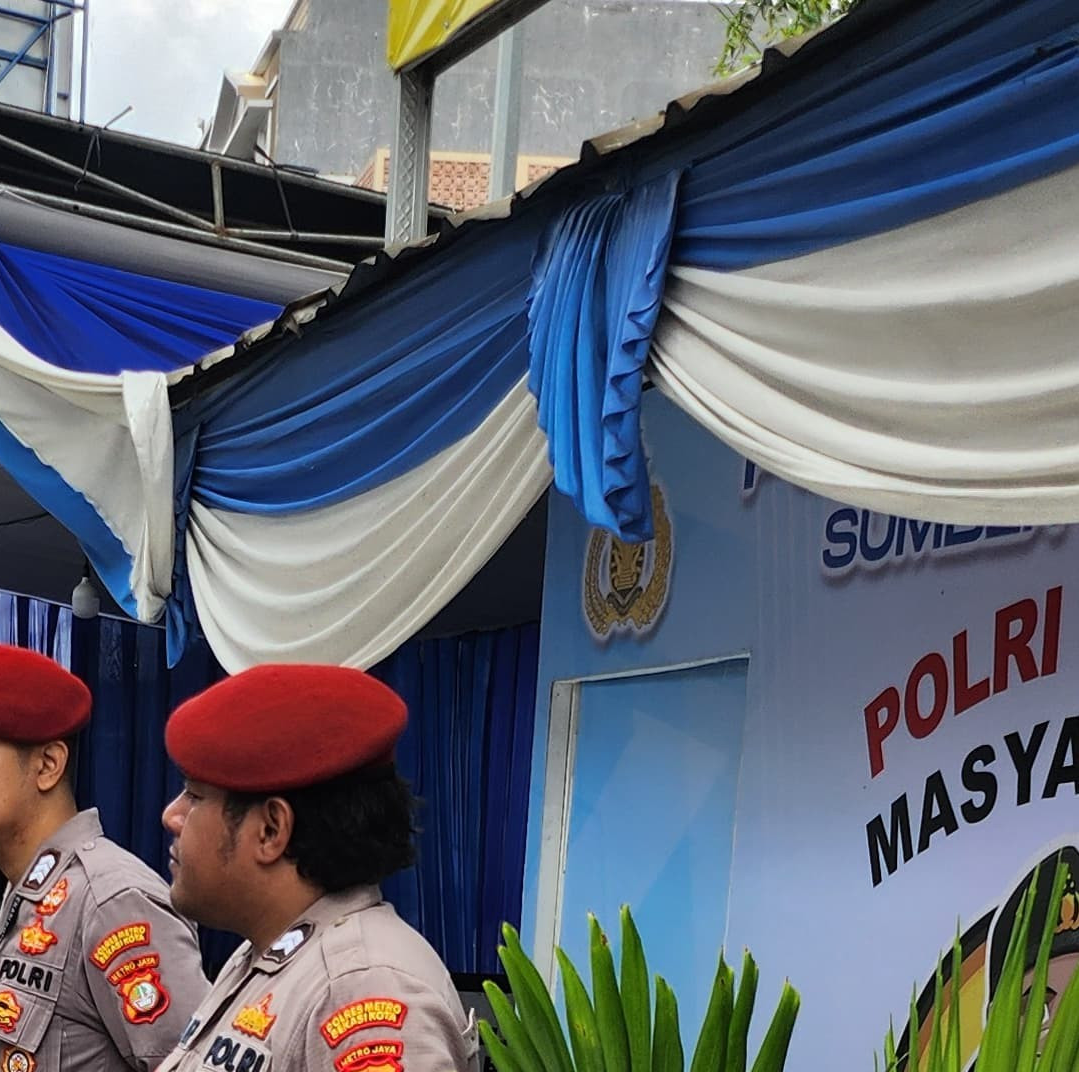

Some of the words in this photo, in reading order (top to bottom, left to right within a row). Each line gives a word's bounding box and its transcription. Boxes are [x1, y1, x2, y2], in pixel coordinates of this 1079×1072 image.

[864, 585, 1062, 778] POLRI
[0, 959, 53, 992] POLRI
[111, 961, 135, 981] METRO
[137, 957, 156, 968] JAYA
[326, 1003, 363, 1033] POLRES
[364, 1001, 401, 1015] METRO
[331, 1013, 368, 1039] BEKASI
[368, 1012, 397, 1022] KOTA
[341, 1046, 370, 1067] METRO
[372, 1045, 397, 1055] JAYA
